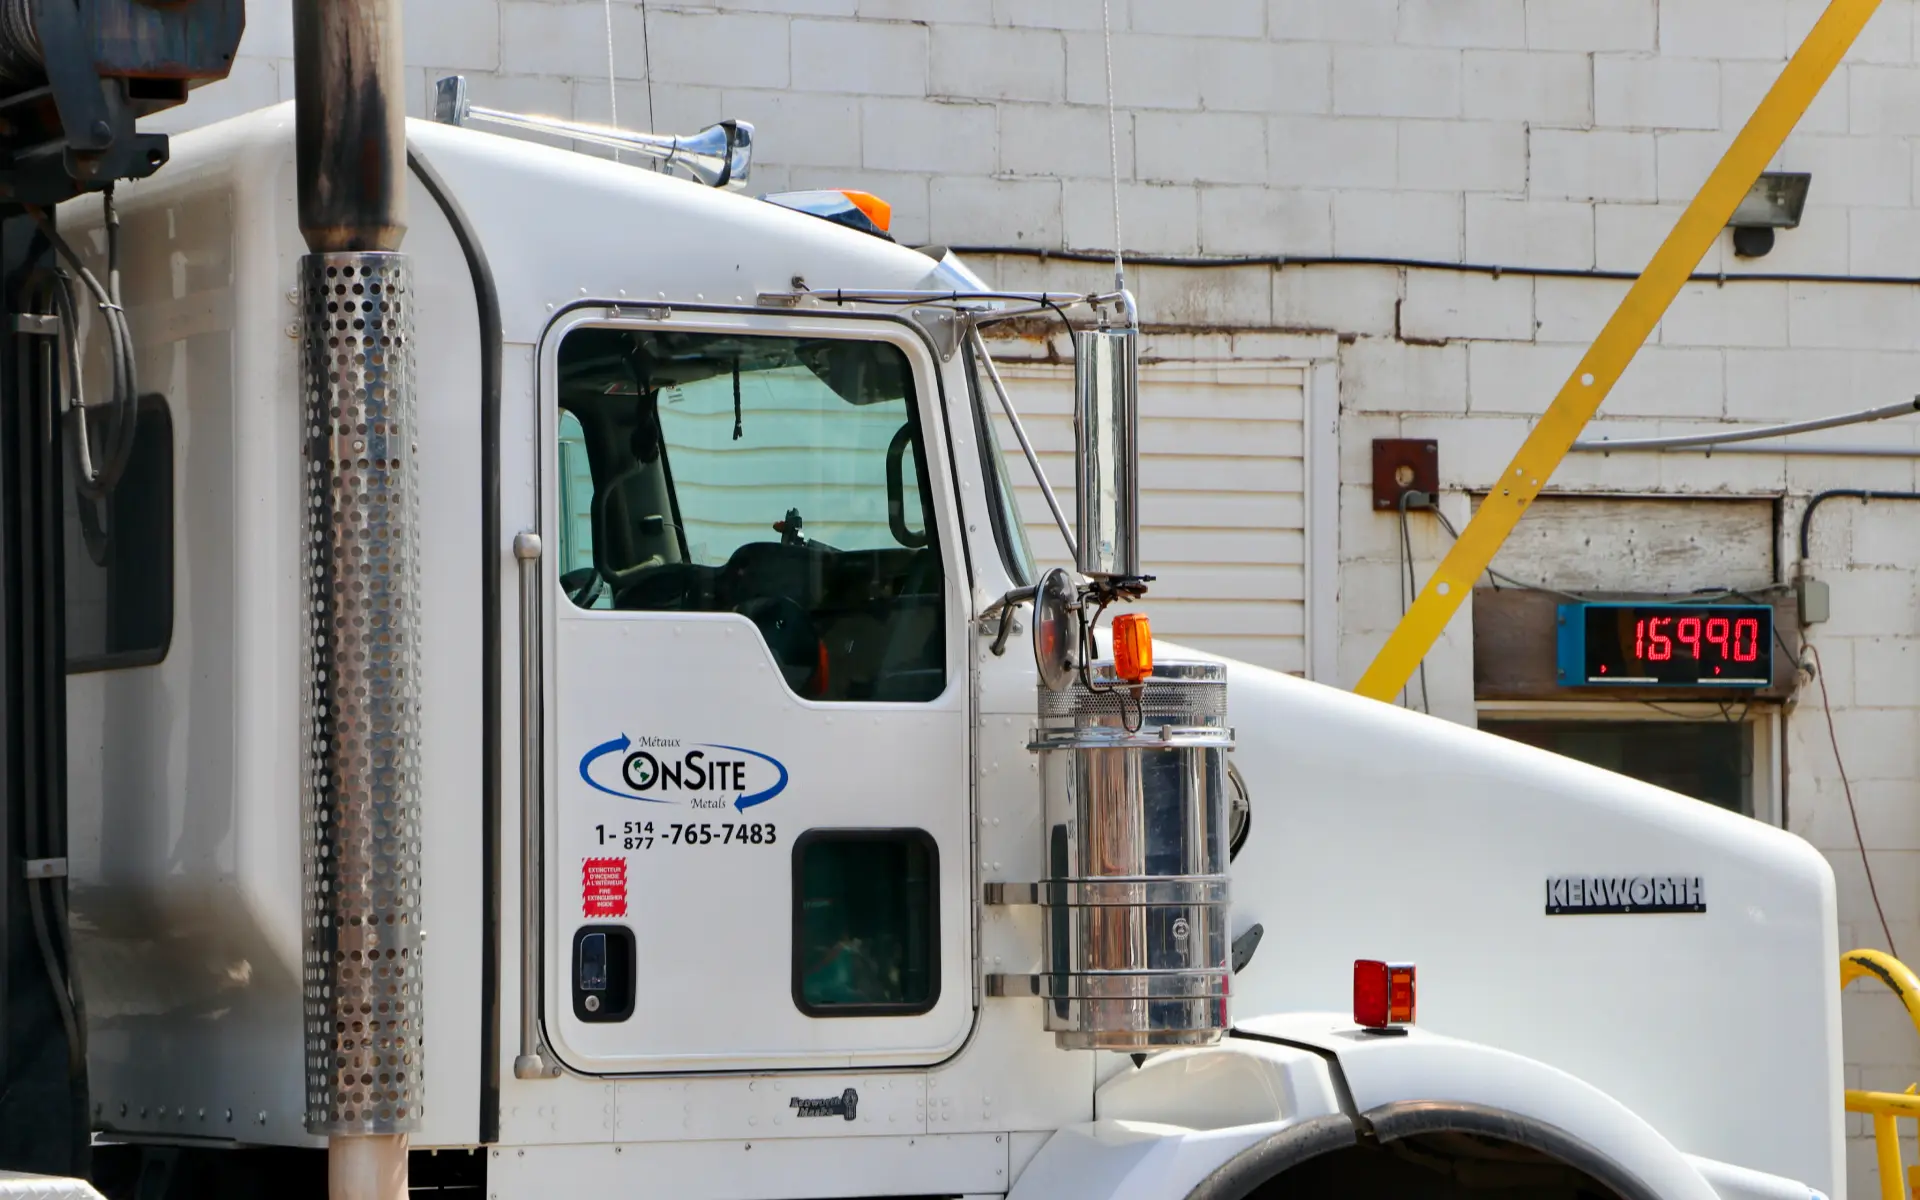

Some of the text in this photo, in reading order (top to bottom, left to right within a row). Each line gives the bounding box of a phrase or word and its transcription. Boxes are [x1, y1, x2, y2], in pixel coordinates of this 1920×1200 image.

[1635, 617, 1758, 662] 16990
[639, 736, 681, 748] Métaux
[690, 795, 727, 809] Metals
[623, 821, 654, 834] 514
[661, 823, 777, 845] -765-7483
[623, 837, 654, 849] 877
[1546, 876, 1706, 908] KENWORTH
